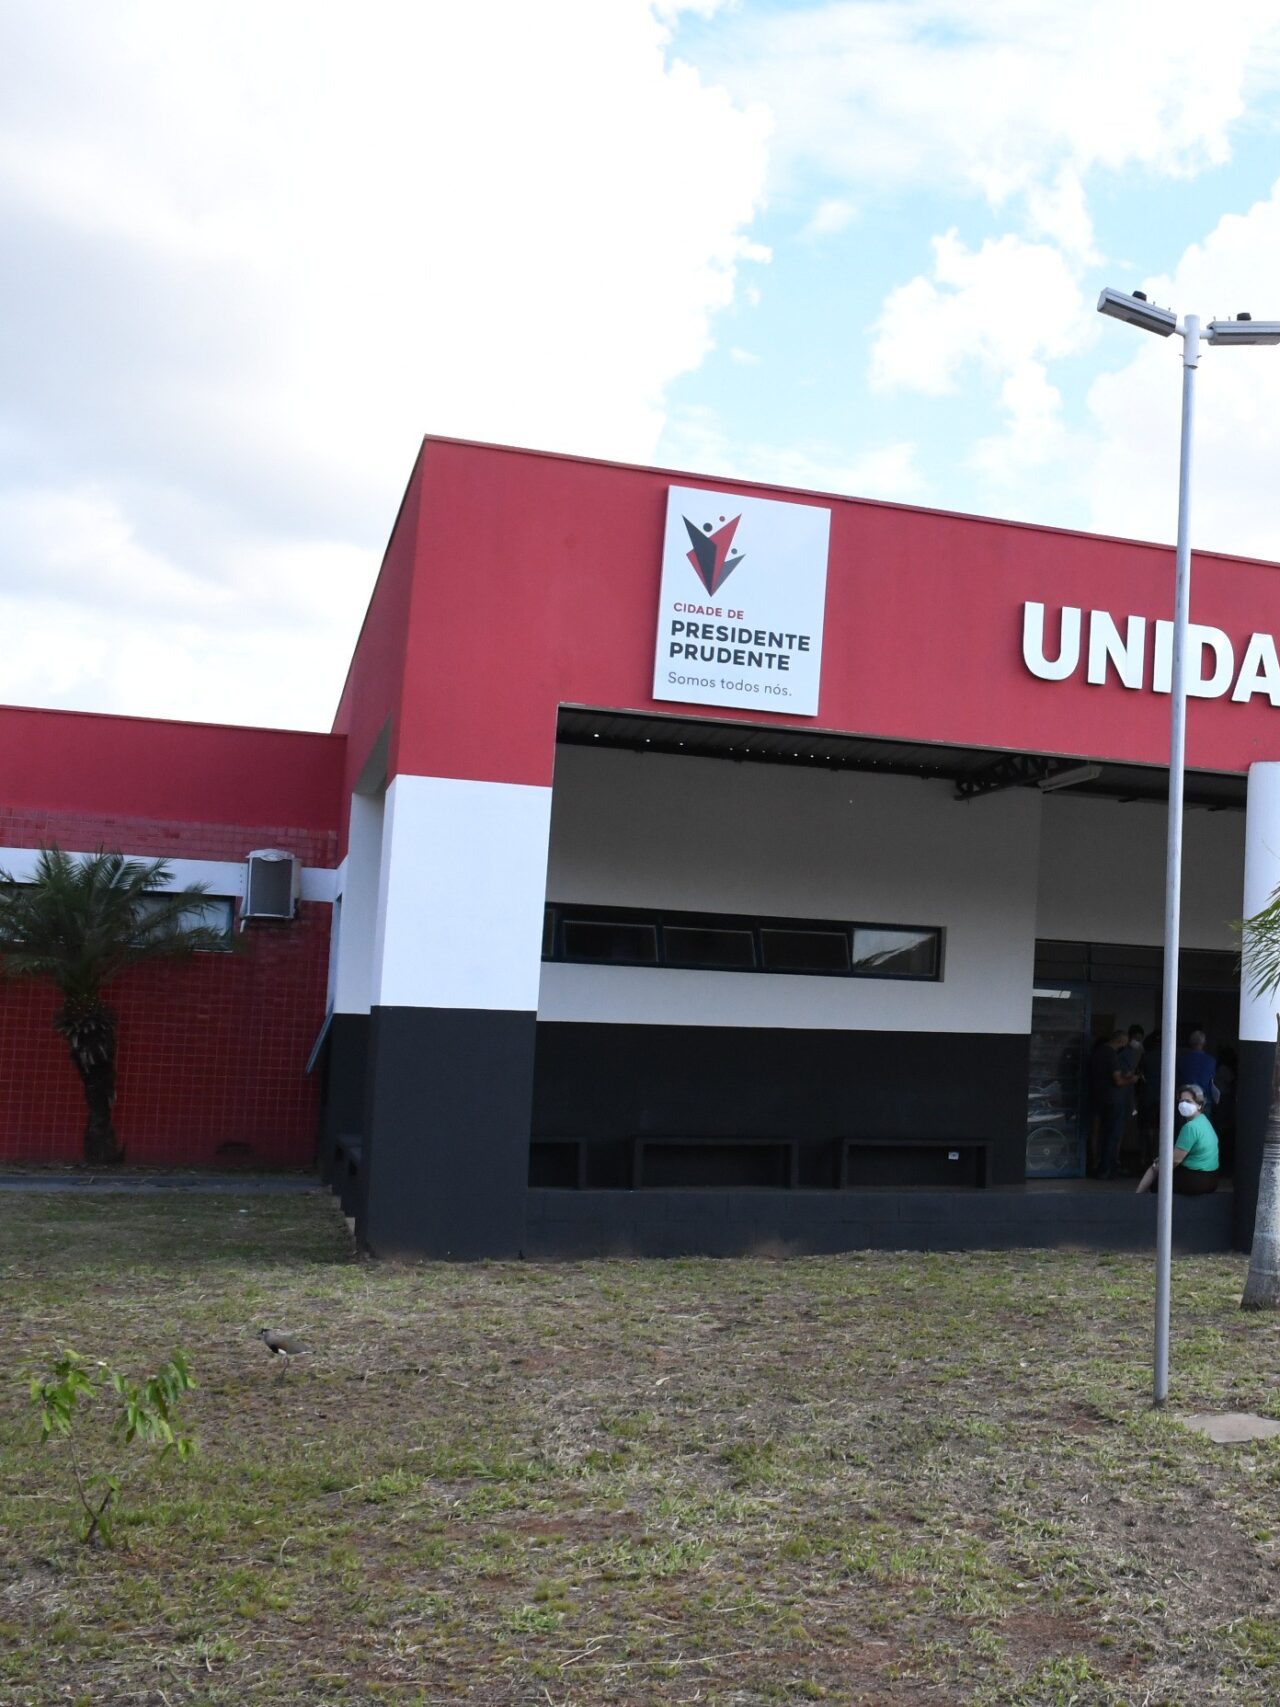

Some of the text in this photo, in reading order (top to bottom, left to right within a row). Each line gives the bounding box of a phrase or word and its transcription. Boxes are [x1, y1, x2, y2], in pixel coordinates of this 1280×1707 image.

[673, 602, 744, 620] CIDADE DE
[671, 619, 810, 652] PRESIDENTE
[669, 641, 790, 671] PRUDENTE
[667, 671, 792, 697] Somos todos nós.
